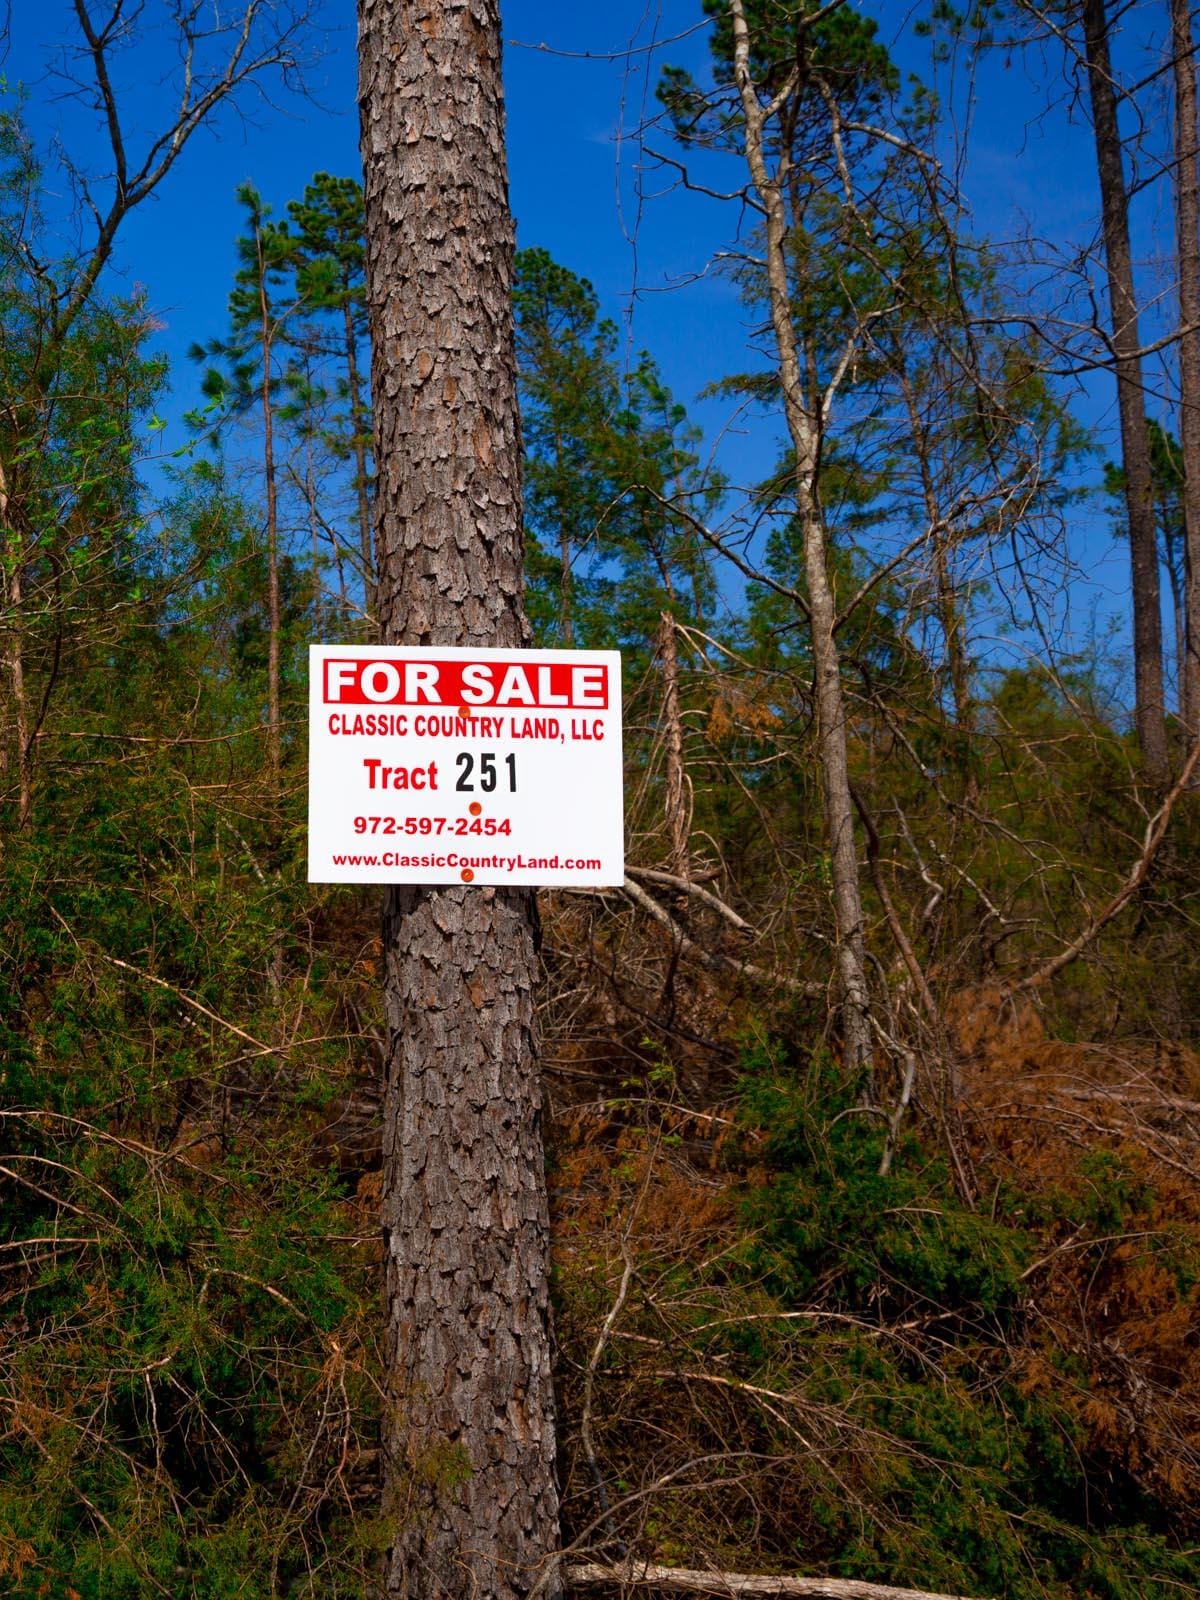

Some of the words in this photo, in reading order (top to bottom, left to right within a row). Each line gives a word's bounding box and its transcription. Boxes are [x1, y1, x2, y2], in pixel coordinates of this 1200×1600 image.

[327, 661, 442, 703] FOR
[460, 663, 604, 707] SALE
[328, 714, 408, 736] CLASSIC
[414, 715, 504, 738] COUNTRY
[511, 717, 565, 744] LAND,
[571, 719, 604, 741] LLC
[363, 759, 439, 790] Tract
[455, 752, 517, 793] 251
[353, 816, 512, 836] 972-597-2454
[332, 852, 602, 871] www.ClassicCountryLand.com
